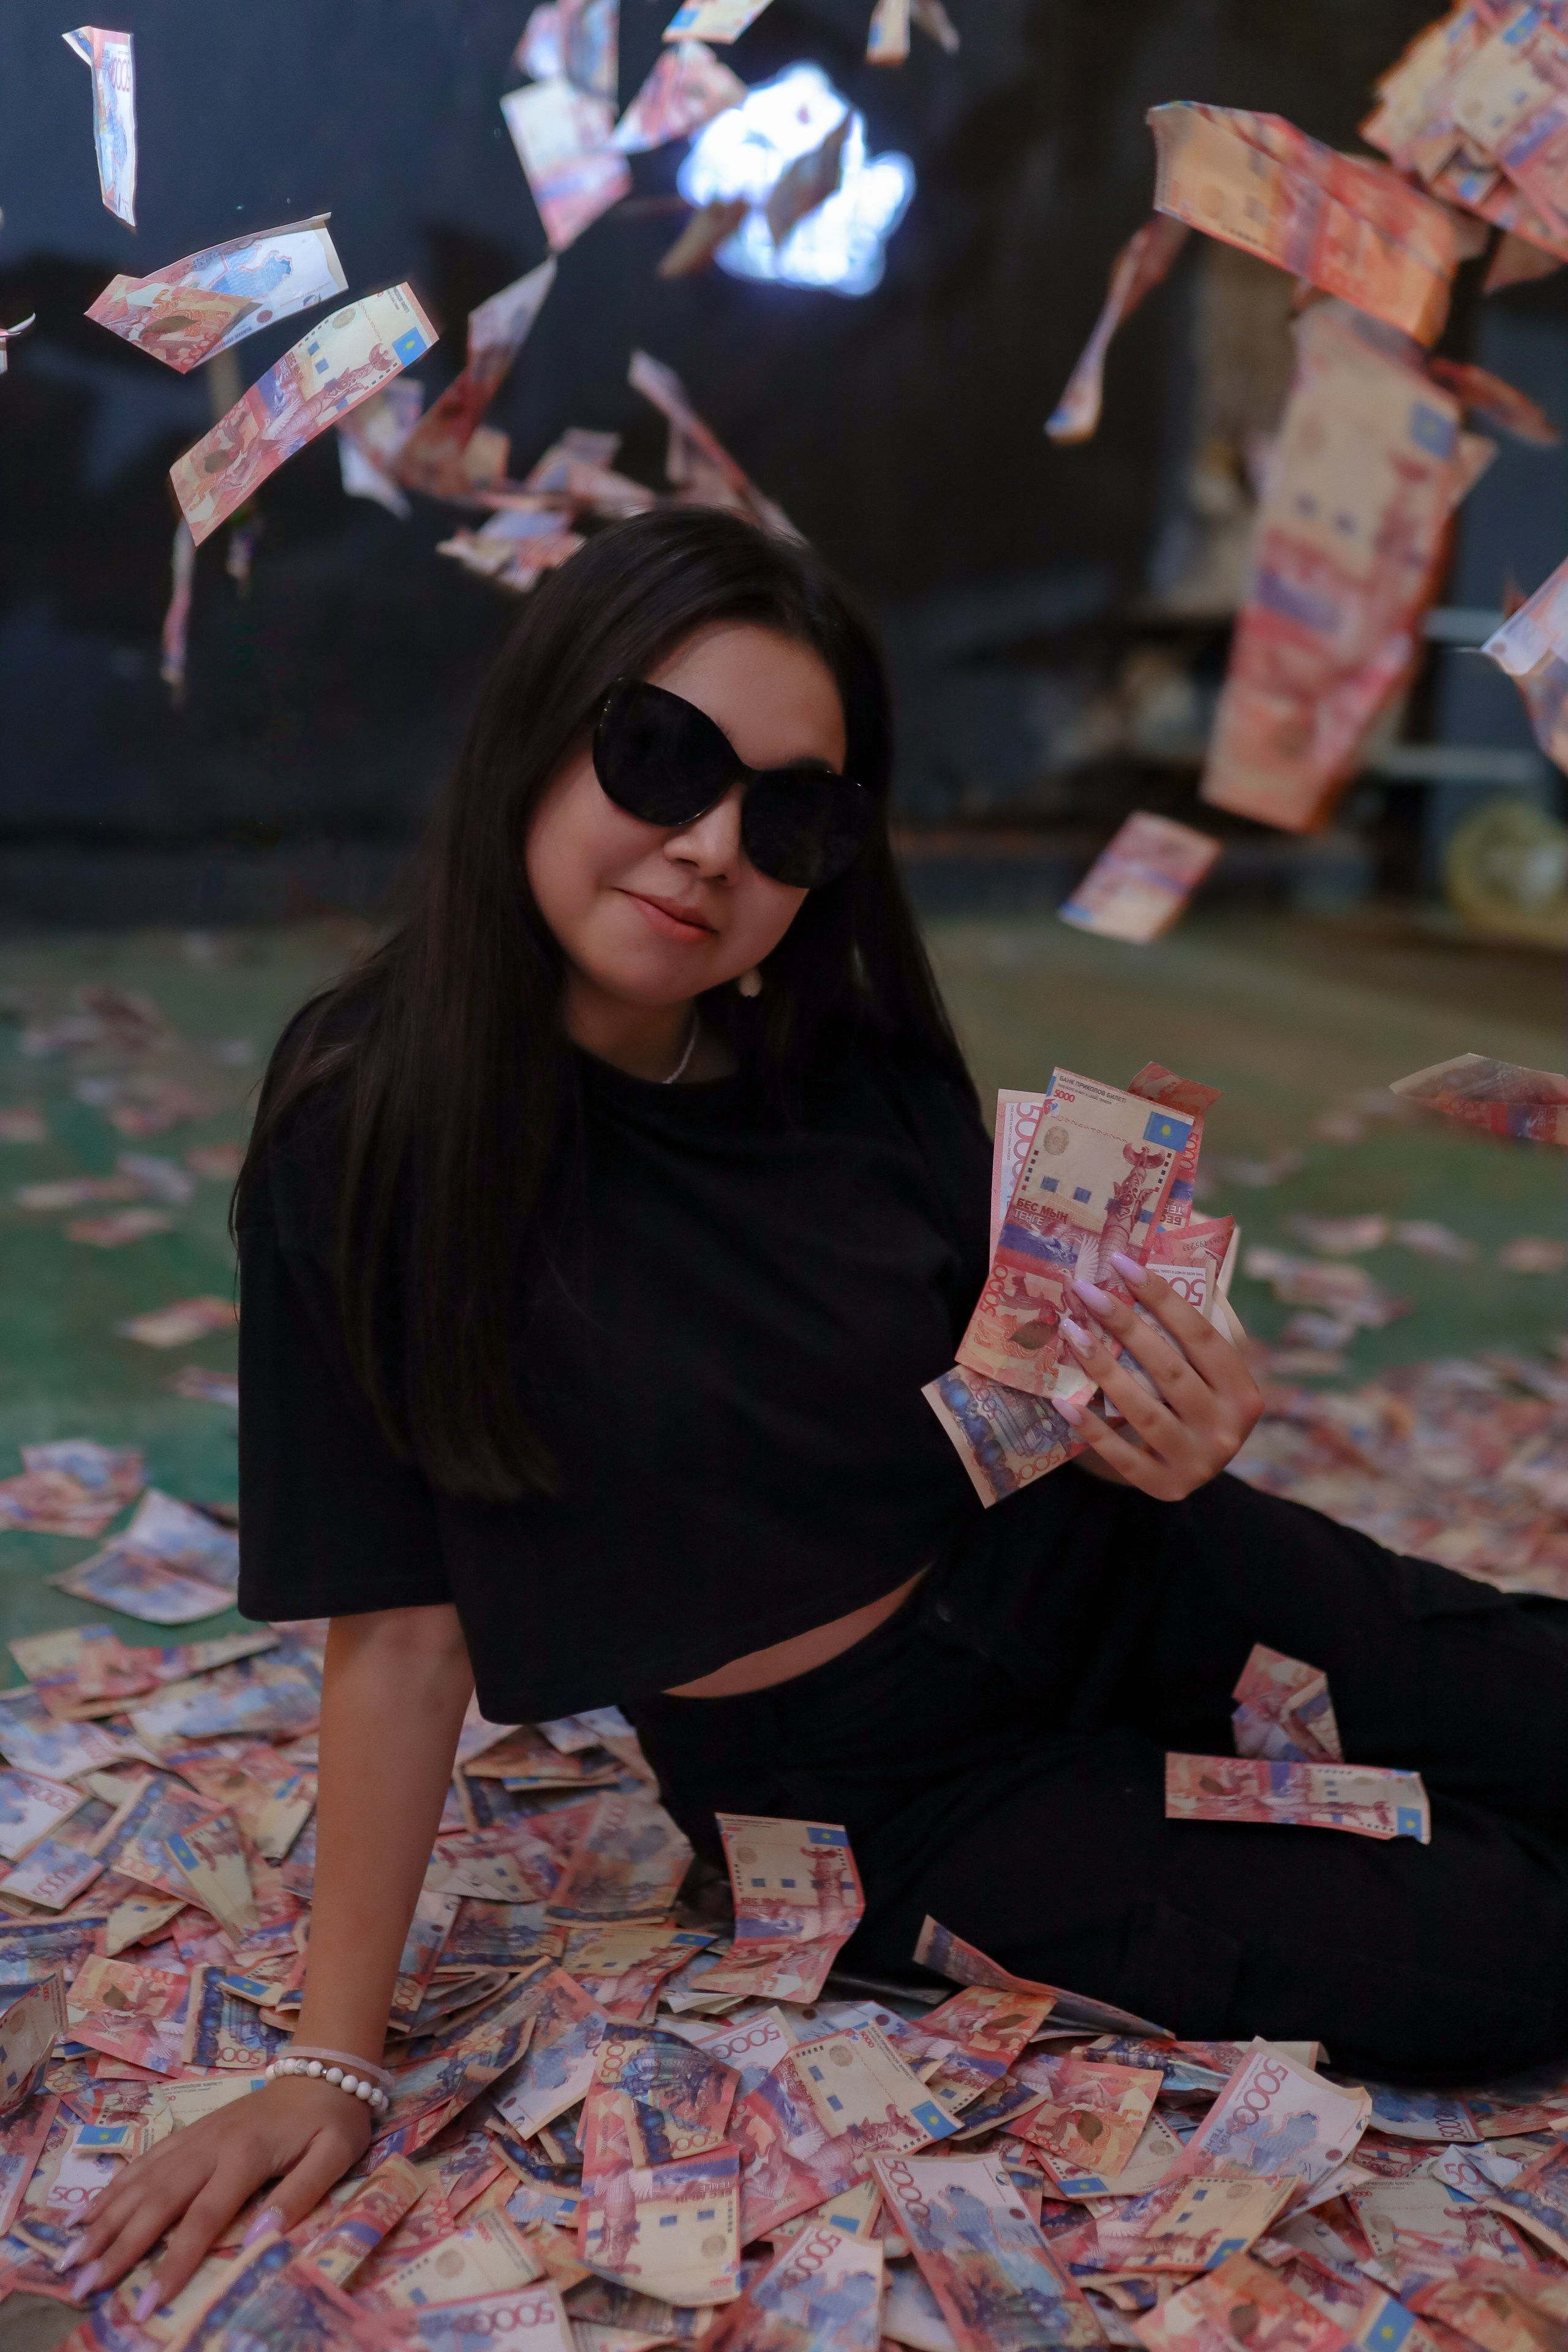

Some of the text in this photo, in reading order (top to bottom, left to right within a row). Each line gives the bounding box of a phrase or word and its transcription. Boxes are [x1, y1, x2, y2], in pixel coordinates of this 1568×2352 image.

[1053, 1089, 1076, 1102] 5000
[1058, 1074, 1075, 1085] БАНК
[1074, 1080, 1106, 1096] ПРИКОЛОВ
[1016, 1197, 1039, 1212] БЕС
[1160, 1215, 1182, 1226] БЕС
[980, 1264, 1009, 1318] 5000
[710, 2022, 782, 2060] 5000
[861, 2030, 875, 2048] 5000
[785, 2057, 800, 2078] БЕС
[1232, 2057, 1289, 2125] 5000
[1434, 2113, 1468, 2139] 5000
[882, 2158, 930, 2217] 5000
[782, 2229, 843, 2285] 5000
[470, 2300, 555, 2335] 5000
